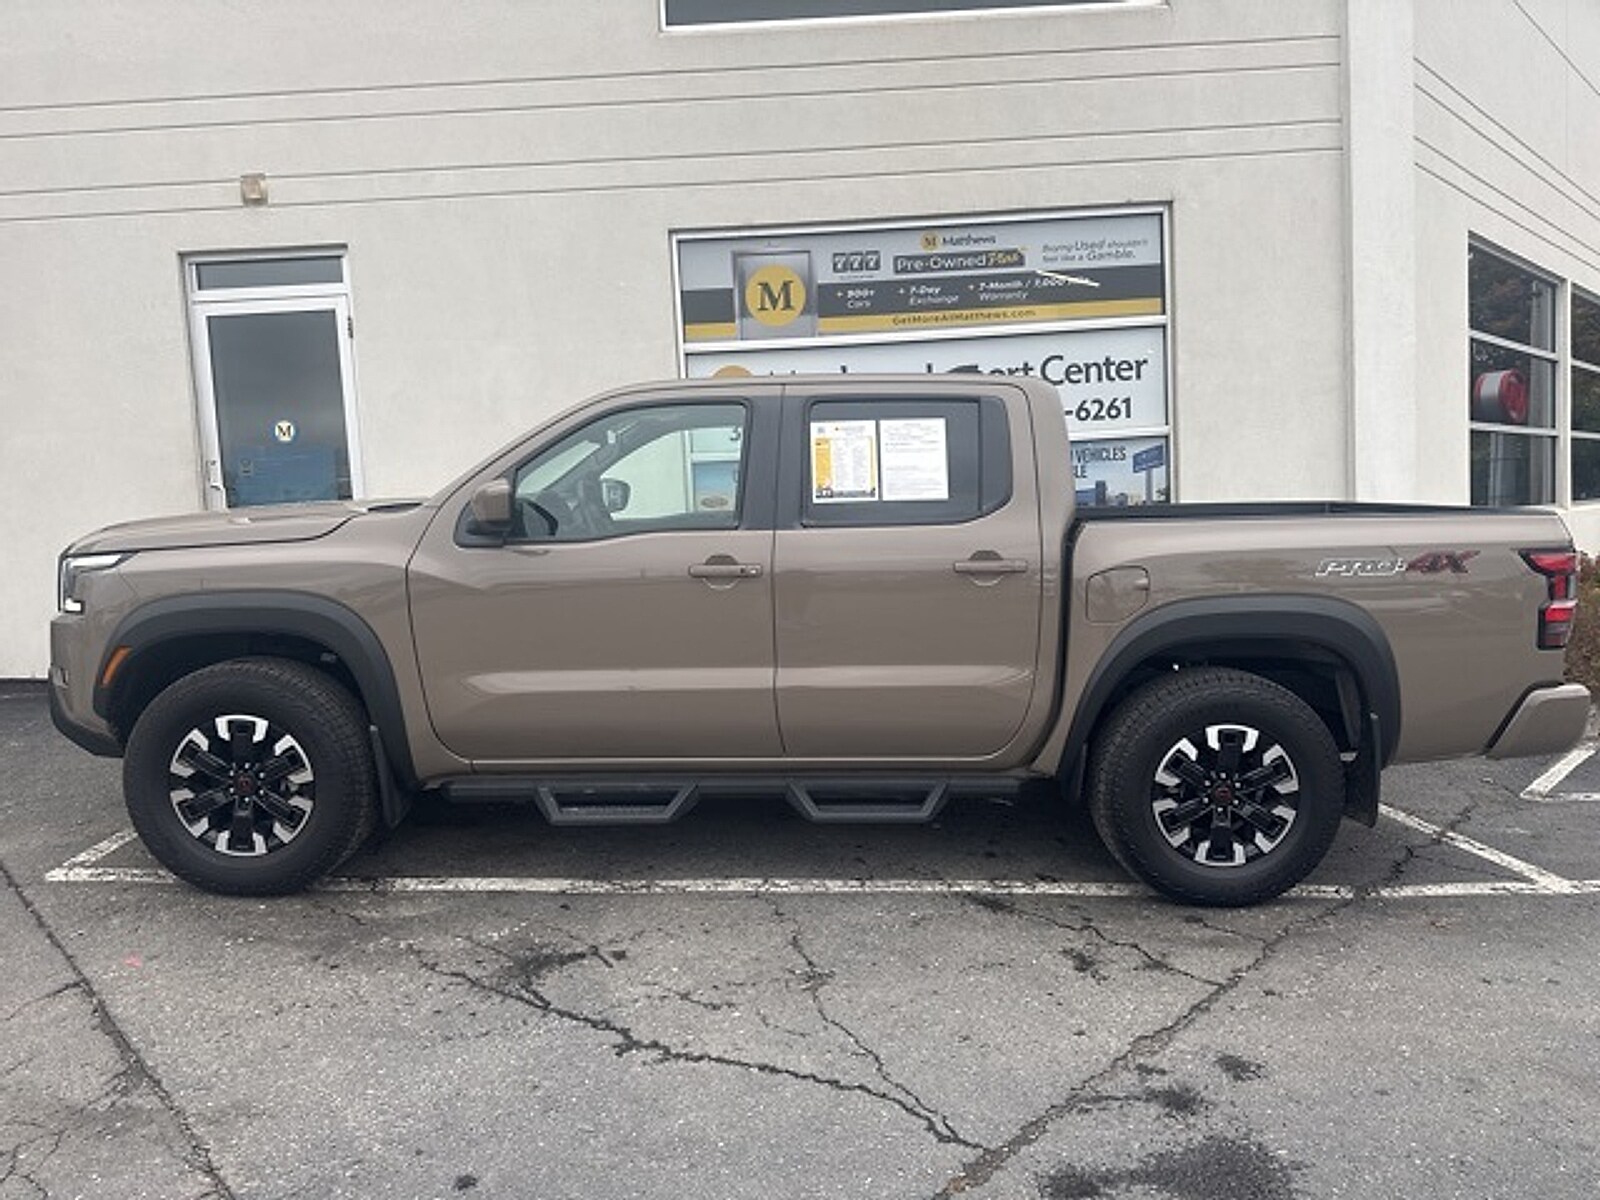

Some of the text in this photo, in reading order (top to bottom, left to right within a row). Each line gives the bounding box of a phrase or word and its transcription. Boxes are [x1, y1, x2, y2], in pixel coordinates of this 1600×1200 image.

[942, 234, 996, 246] Matthews
[1075, 238, 1105, 251] Used
[757, 280, 794, 311] M
[910, 295, 959, 306] Exchange
[979, 291, 1029, 301] Warranty
[1040, 355, 1149, 386] Center
[277, 425, 292, 437] M
